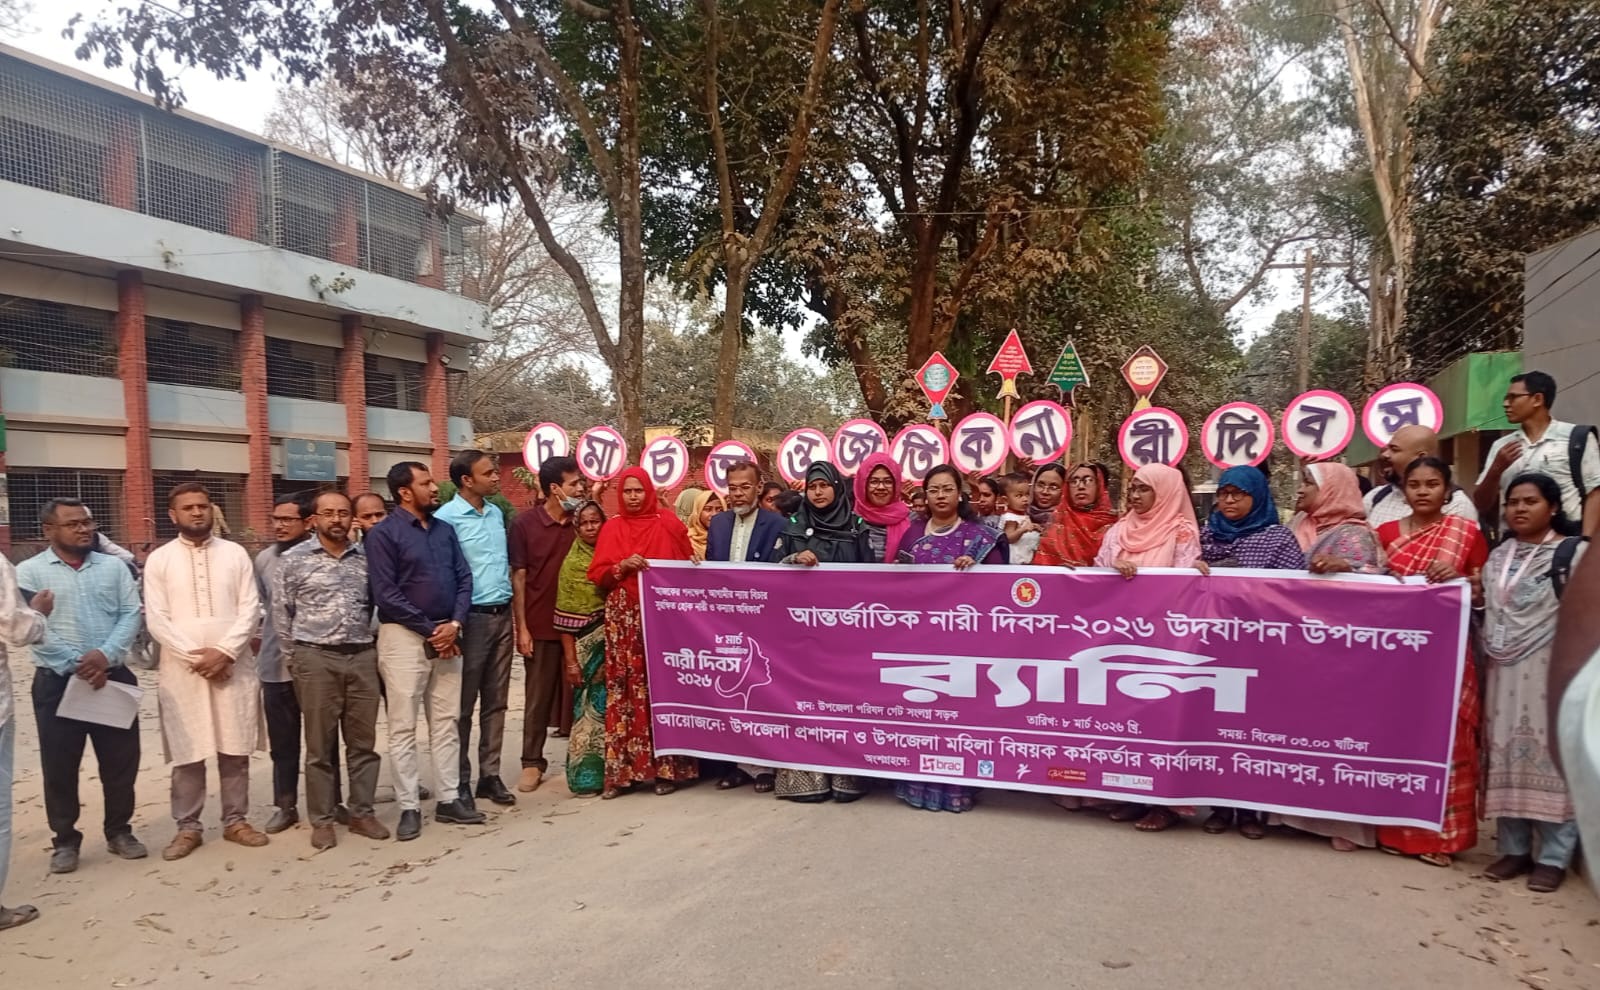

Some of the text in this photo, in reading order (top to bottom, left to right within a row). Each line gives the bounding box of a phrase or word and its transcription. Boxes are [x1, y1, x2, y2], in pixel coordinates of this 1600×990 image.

[960, 426, 994, 468] ক
[787, 602, 922, 629] আন্তর্জাতিক
[927, 604, 981, 632] নারী
[990, 606, 1154, 639] দিবস-২০২৬
[1298, 616, 1432, 651] উপলক্ষে
[715, 632, 743, 644] ৮ মার্চ
[663, 648, 742, 672] নারী দিবস
[677, 672, 712, 687] ২০২৬
[818, 700, 853, 712] উপজেলা
[856, 703, 884, 715] পরিষদ
[887, 705, 904, 716] গেট
[934, 710, 958, 720] সড়ক
[1062, 719, 1070, 727] ৮
[1074, 717, 1091, 728] মার্চ
[1095, 721, 1124, 732] ২০২৬
[729, 715, 793, 738] উপজেলা
[795, 727, 848, 744] প্রশাসন
[854, 732, 866, 743] ও
[872, 726, 942, 750] উপজেলা
[945, 734, 994, 758] মহিলা
[999, 737, 1057, 759] বিষয়ক
[1062, 741, 1145, 767] কর্মকর্তার
[1148, 750, 1223, 774] কার্যালয়,
[1231, 751, 1328, 785] বিরামপুর,
[1249, 728, 1287, 746] বিকেল
[1334, 737, 1369, 752] ঘটিকা
[936, 759, 961, 771] brac
